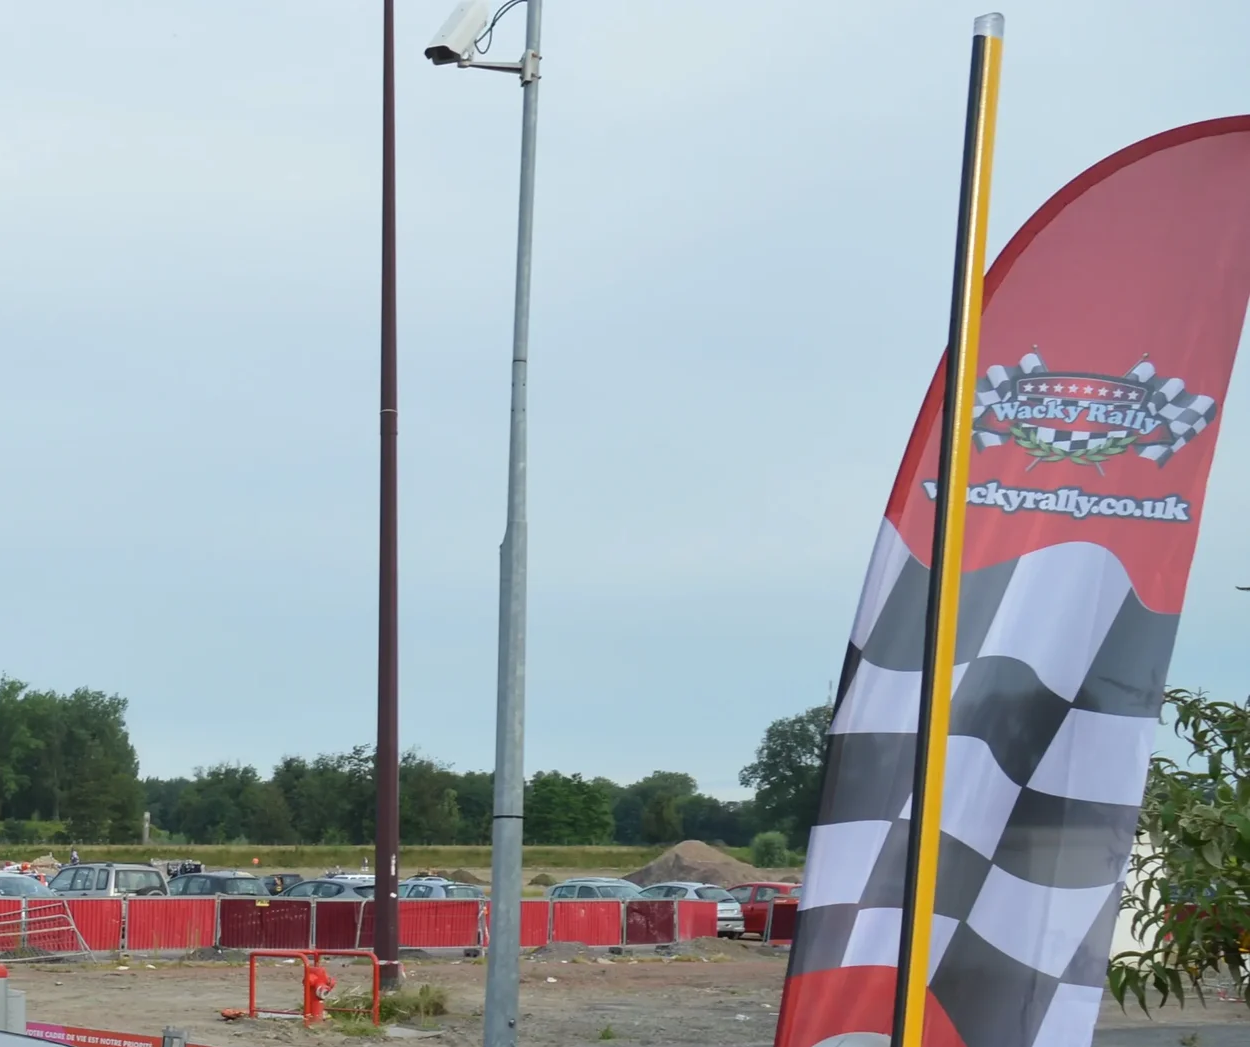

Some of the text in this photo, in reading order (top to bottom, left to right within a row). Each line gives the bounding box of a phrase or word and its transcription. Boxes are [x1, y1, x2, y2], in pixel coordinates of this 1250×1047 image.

[991, 400, 1163, 435] Wacky Rally
[922, 479, 1189, 521] ckyrally.co.uk
[66, 1034, 75, 1042] DE
[76, 1035, 87, 1043] VIE
[88, 1036, 99, 1044] EST
[100, 1037, 123, 1047] NOTRE
